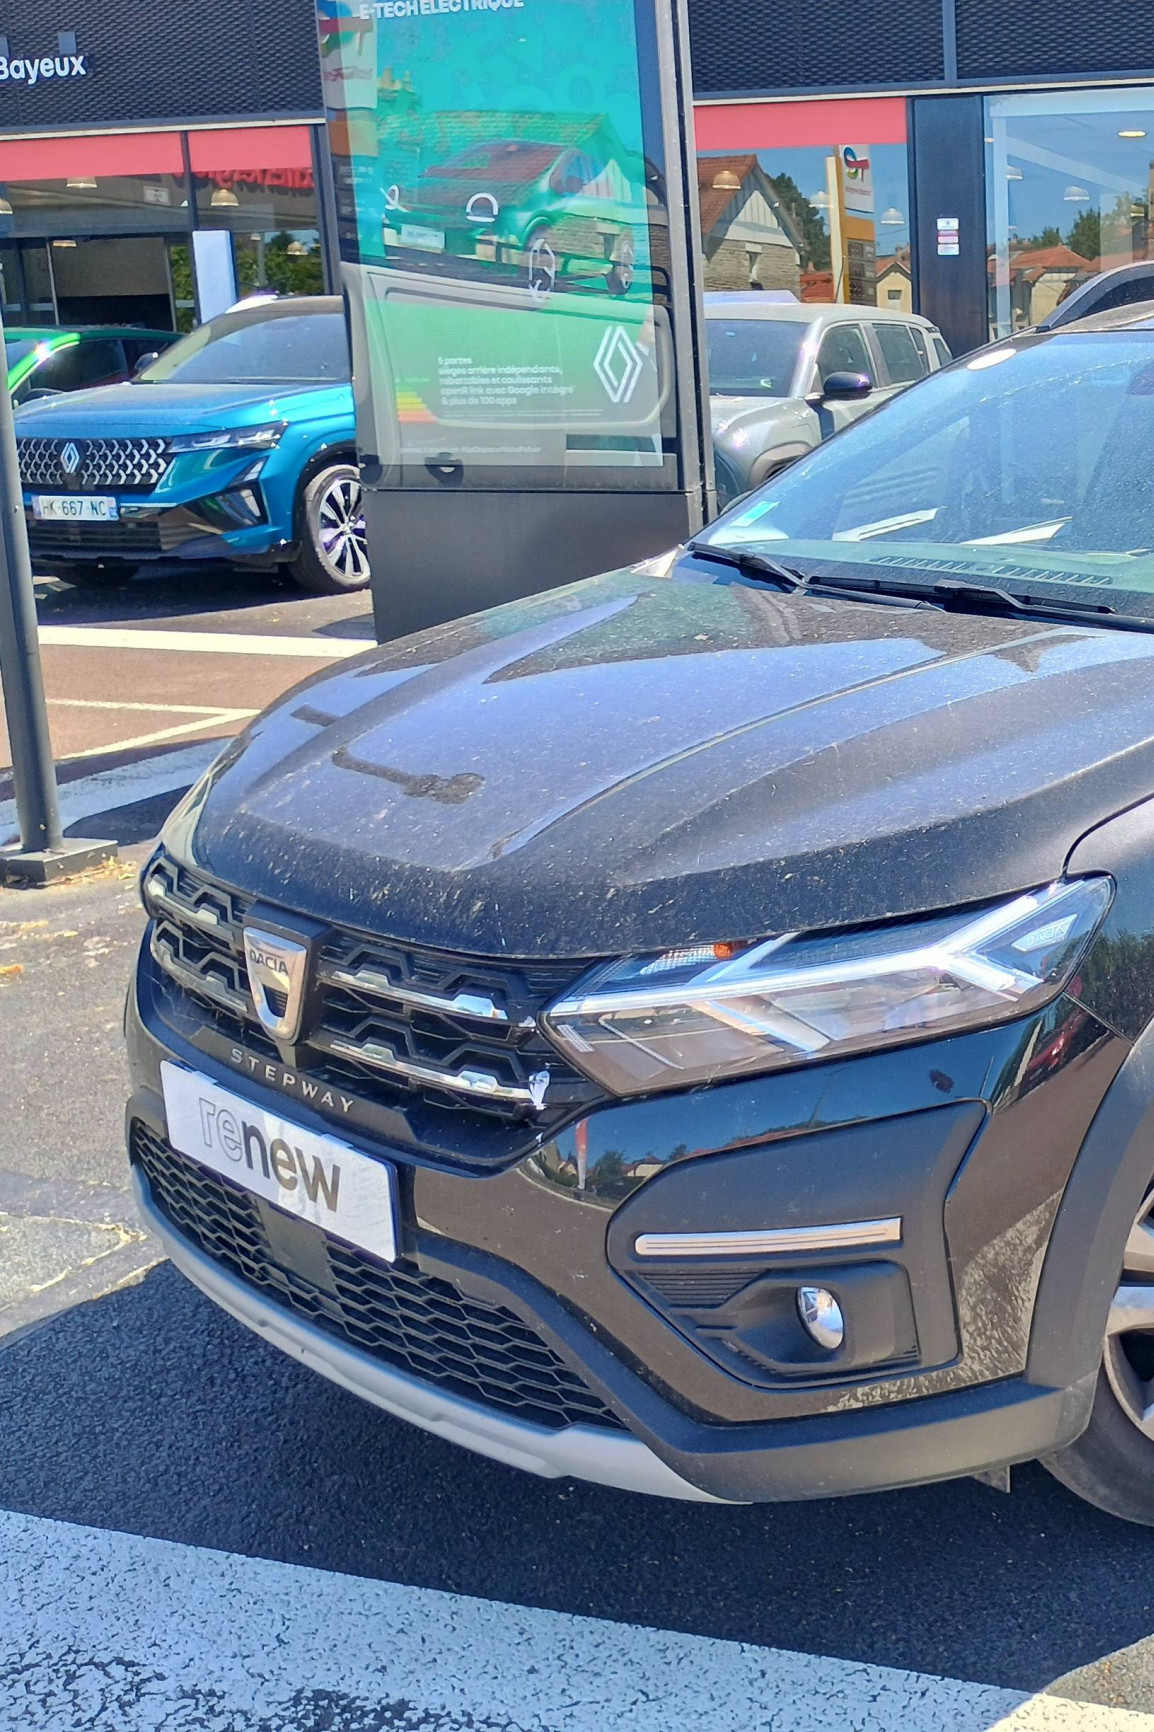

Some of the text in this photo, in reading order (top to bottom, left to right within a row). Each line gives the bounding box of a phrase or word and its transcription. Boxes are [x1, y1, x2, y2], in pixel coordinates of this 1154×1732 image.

[0, 55, 87, 85] Bayeux
[507, 386, 540, 397] Google
[250, 948, 290, 976] DACIA
[230, 1048, 355, 1113] STEPWAY
[199, 1097, 341, 1213] renew
